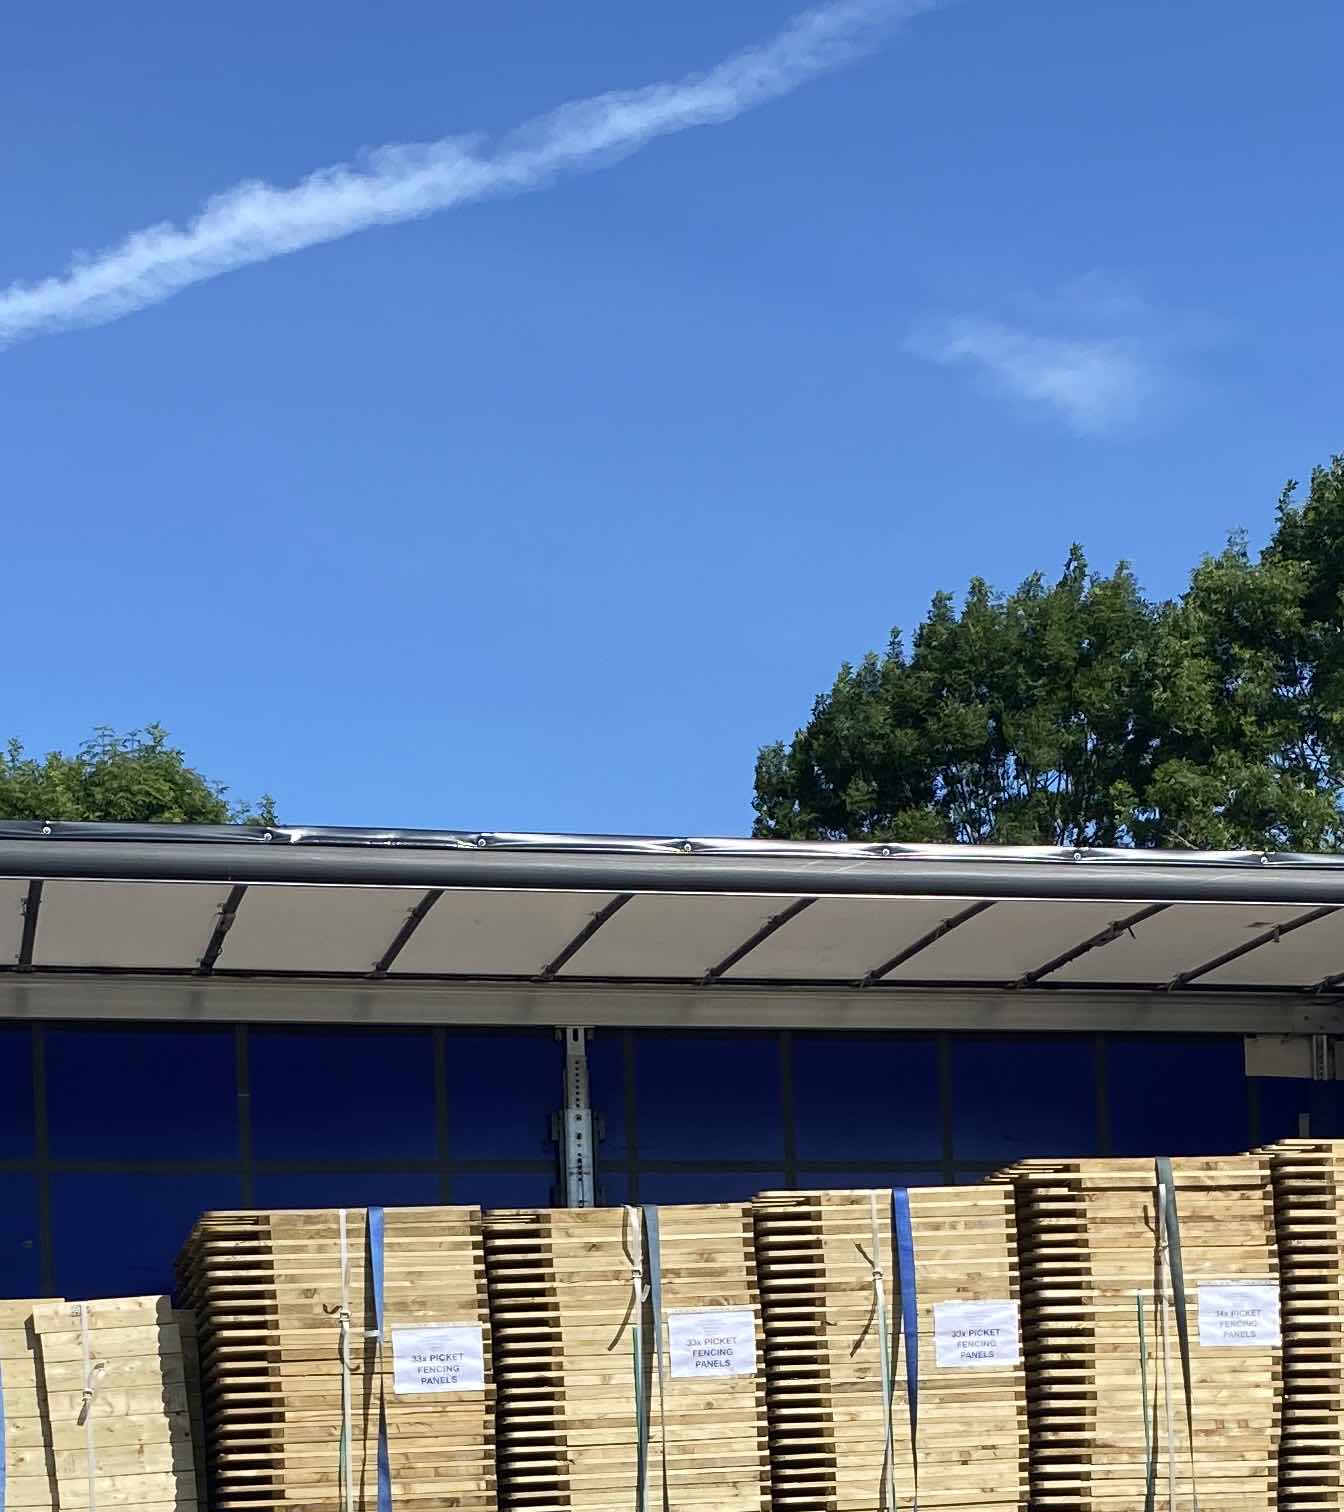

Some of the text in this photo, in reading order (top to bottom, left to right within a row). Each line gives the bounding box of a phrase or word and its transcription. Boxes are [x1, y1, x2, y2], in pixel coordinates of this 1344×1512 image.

[968, 1328, 1001, 1337] PICKET
[704, 1337, 737, 1345] PICKET
[957, 1340, 997, 1348] FENCING
[692, 1348, 734, 1357] FENCING
[960, 1350, 994, 1359] PANELS
[429, 1353, 464, 1362] PICKET
[696, 1359, 731, 1368] PANELS
[418, 1365, 460, 1373] FENCING
[421, 1376, 457, 1384] PANELS
